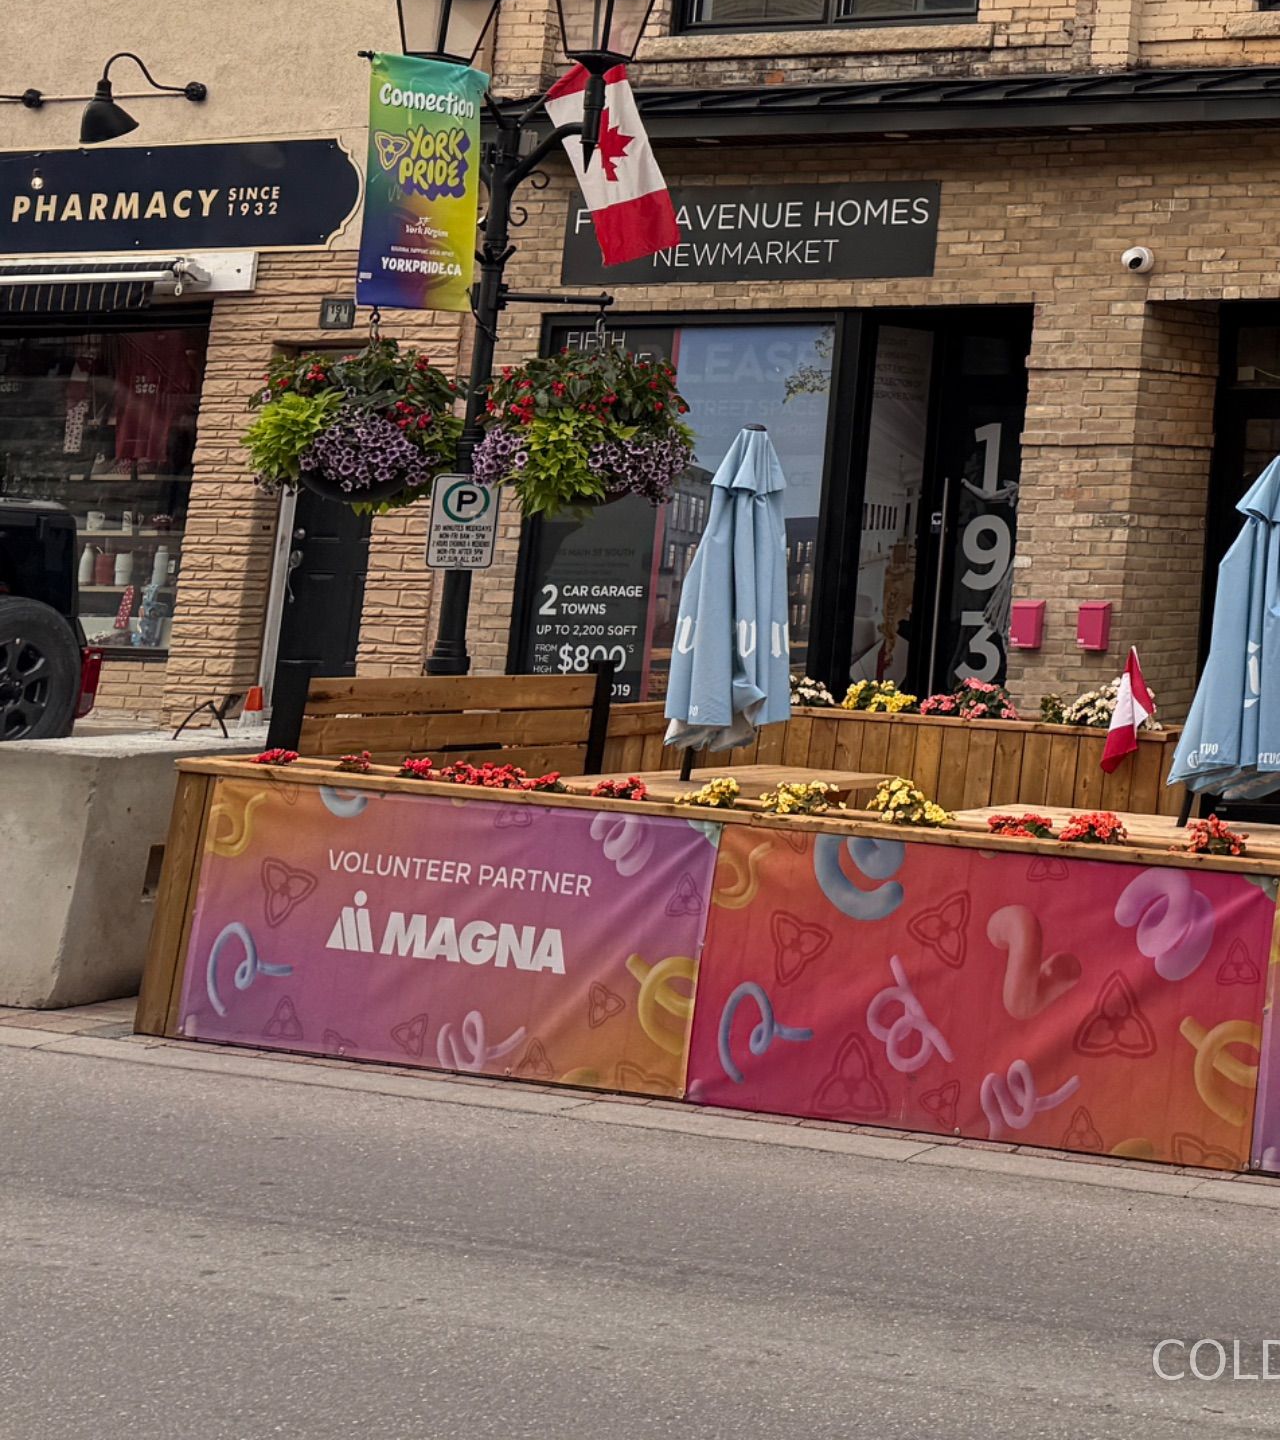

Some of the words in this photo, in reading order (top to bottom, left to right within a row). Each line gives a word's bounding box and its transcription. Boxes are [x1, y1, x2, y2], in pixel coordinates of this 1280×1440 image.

[380, 83, 474, 118] Connection
[407, 125, 465, 161] YORK
[399, 157, 460, 190] PRIDE
[227, 186, 280, 200] SINCE
[11, 189, 219, 223] PHARMACY
[227, 202, 278, 216] 1932
[675, 201, 804, 231] AVENUE
[813, 197, 930, 227] HOMES
[653, 238, 839, 267] NEWMARKET
[381, 256, 462, 277] YORKPRIDE.CA
[456, 490, 478, 512] P
[538, 584, 558, 615] 2
[563, 585, 588, 597] CAR
[591, 585, 643, 598] GARAGE
[561, 603, 607, 615] TOWNS
[536, 624, 552, 636] UP
[554, 624, 570, 636] TO
[572, 624, 605, 637] 2,200
[607, 625, 638, 636] SQFT
[534, 643, 558, 652] FROM
[534, 654, 549, 663] THE
[533, 665, 552, 673] HIGH
[328, 848, 473, 886] VOLUNTEER
[478, 864, 593, 898] PARTNER
[379, 910, 567, 975] MAGNA
